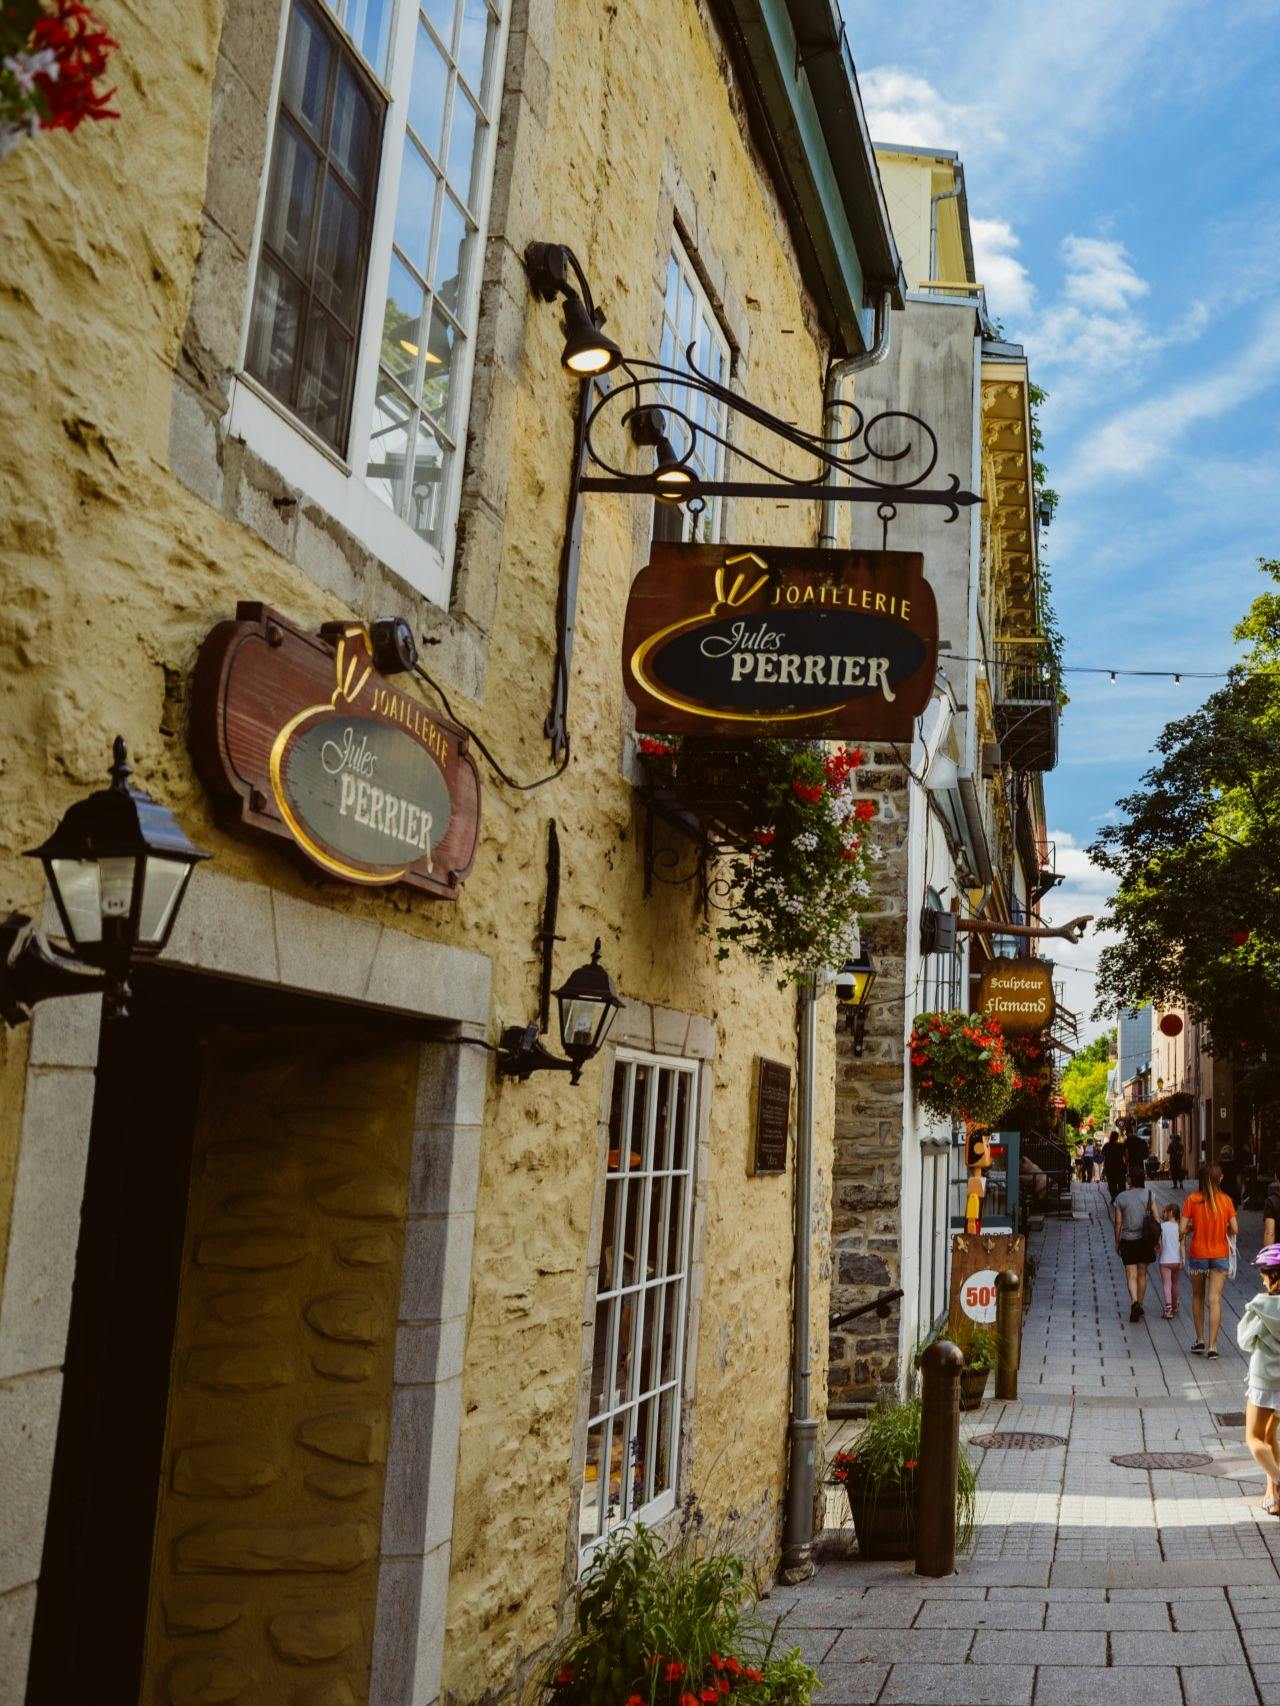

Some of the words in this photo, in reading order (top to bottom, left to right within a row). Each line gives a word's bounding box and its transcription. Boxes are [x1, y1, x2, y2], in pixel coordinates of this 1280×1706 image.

[771, 586, 911, 622] JOAILLERIE
[700, 622, 786, 658] Jules
[731, 653, 896, 702] PERRIER
[321, 727, 378, 777] Jules
[371, 689, 448, 768] JOAILLERIE
[339, 773, 434, 875] PERRIER
[990, 976, 1043, 991] Sculpteur
